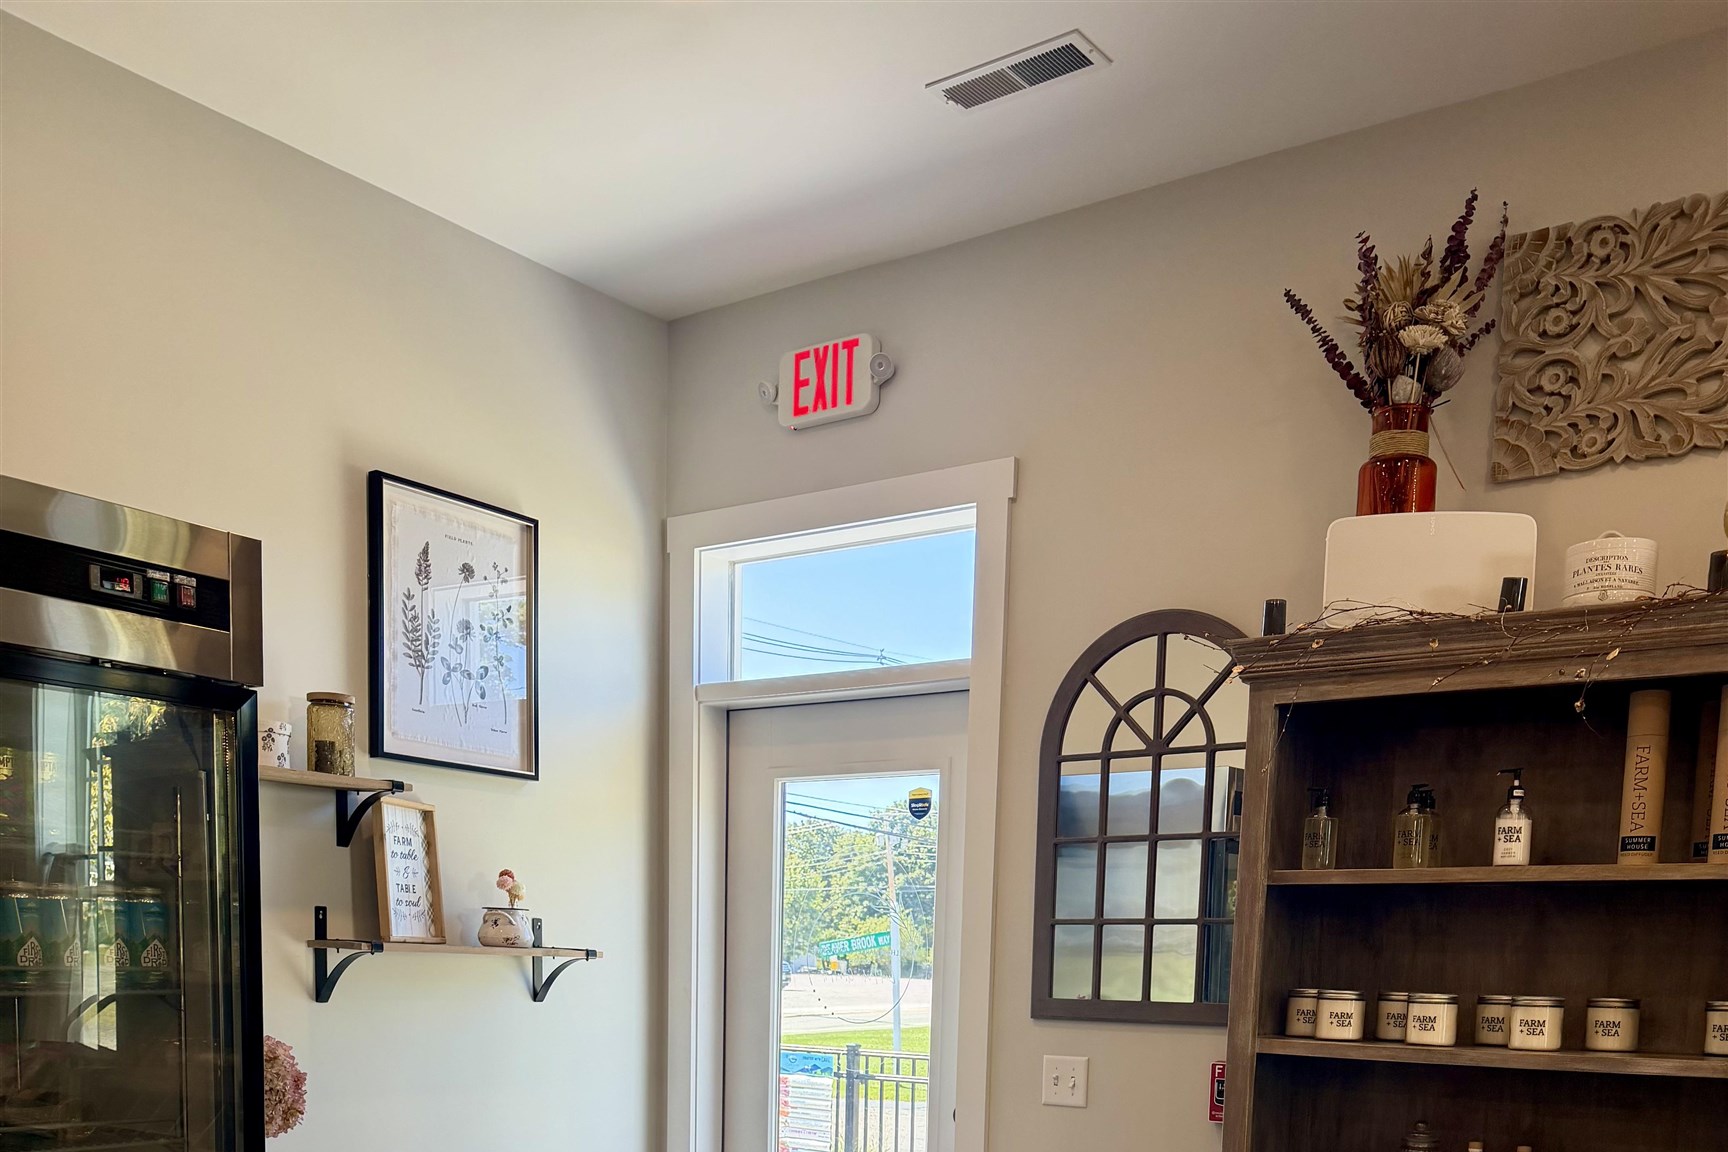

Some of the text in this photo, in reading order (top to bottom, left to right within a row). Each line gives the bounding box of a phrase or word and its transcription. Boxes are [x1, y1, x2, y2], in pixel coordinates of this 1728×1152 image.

[793, 337, 860, 418] EXIT
[1586, 555, 1629, 564] DESCRIPTION
[1572, 563, 1643, 578] PLANTES RARES
[1629, 745, 1651, 833] FARM+SEA
[1498, 826, 1522, 835] FARM
[393, 835, 412, 847] FARM
[1503, 835, 1521, 843] SEA
[390, 848, 419, 861] to table
[396, 883, 417, 894] TABLE
[395, 895, 421, 908] to soul
[850, 935, 877, 950] BROOK
[877, 935, 890, 945] WAY
[1329, 1011, 1353, 1020] FARM
[1412, 1015, 1437, 1024] FARM
[1336, 1019, 1352, 1028] SEA
[1481, 1016, 1505, 1025] FARM
[1519, 1019, 1546, 1028] FARM
[1595, 1020, 1621, 1029] FARM
[1418, 1023, 1435, 1032] SEA
[1487, 1024, 1504, 1033] SEA
[1526, 1027, 1545, 1036] SEA
[1601, 1028, 1620, 1037] SEA
